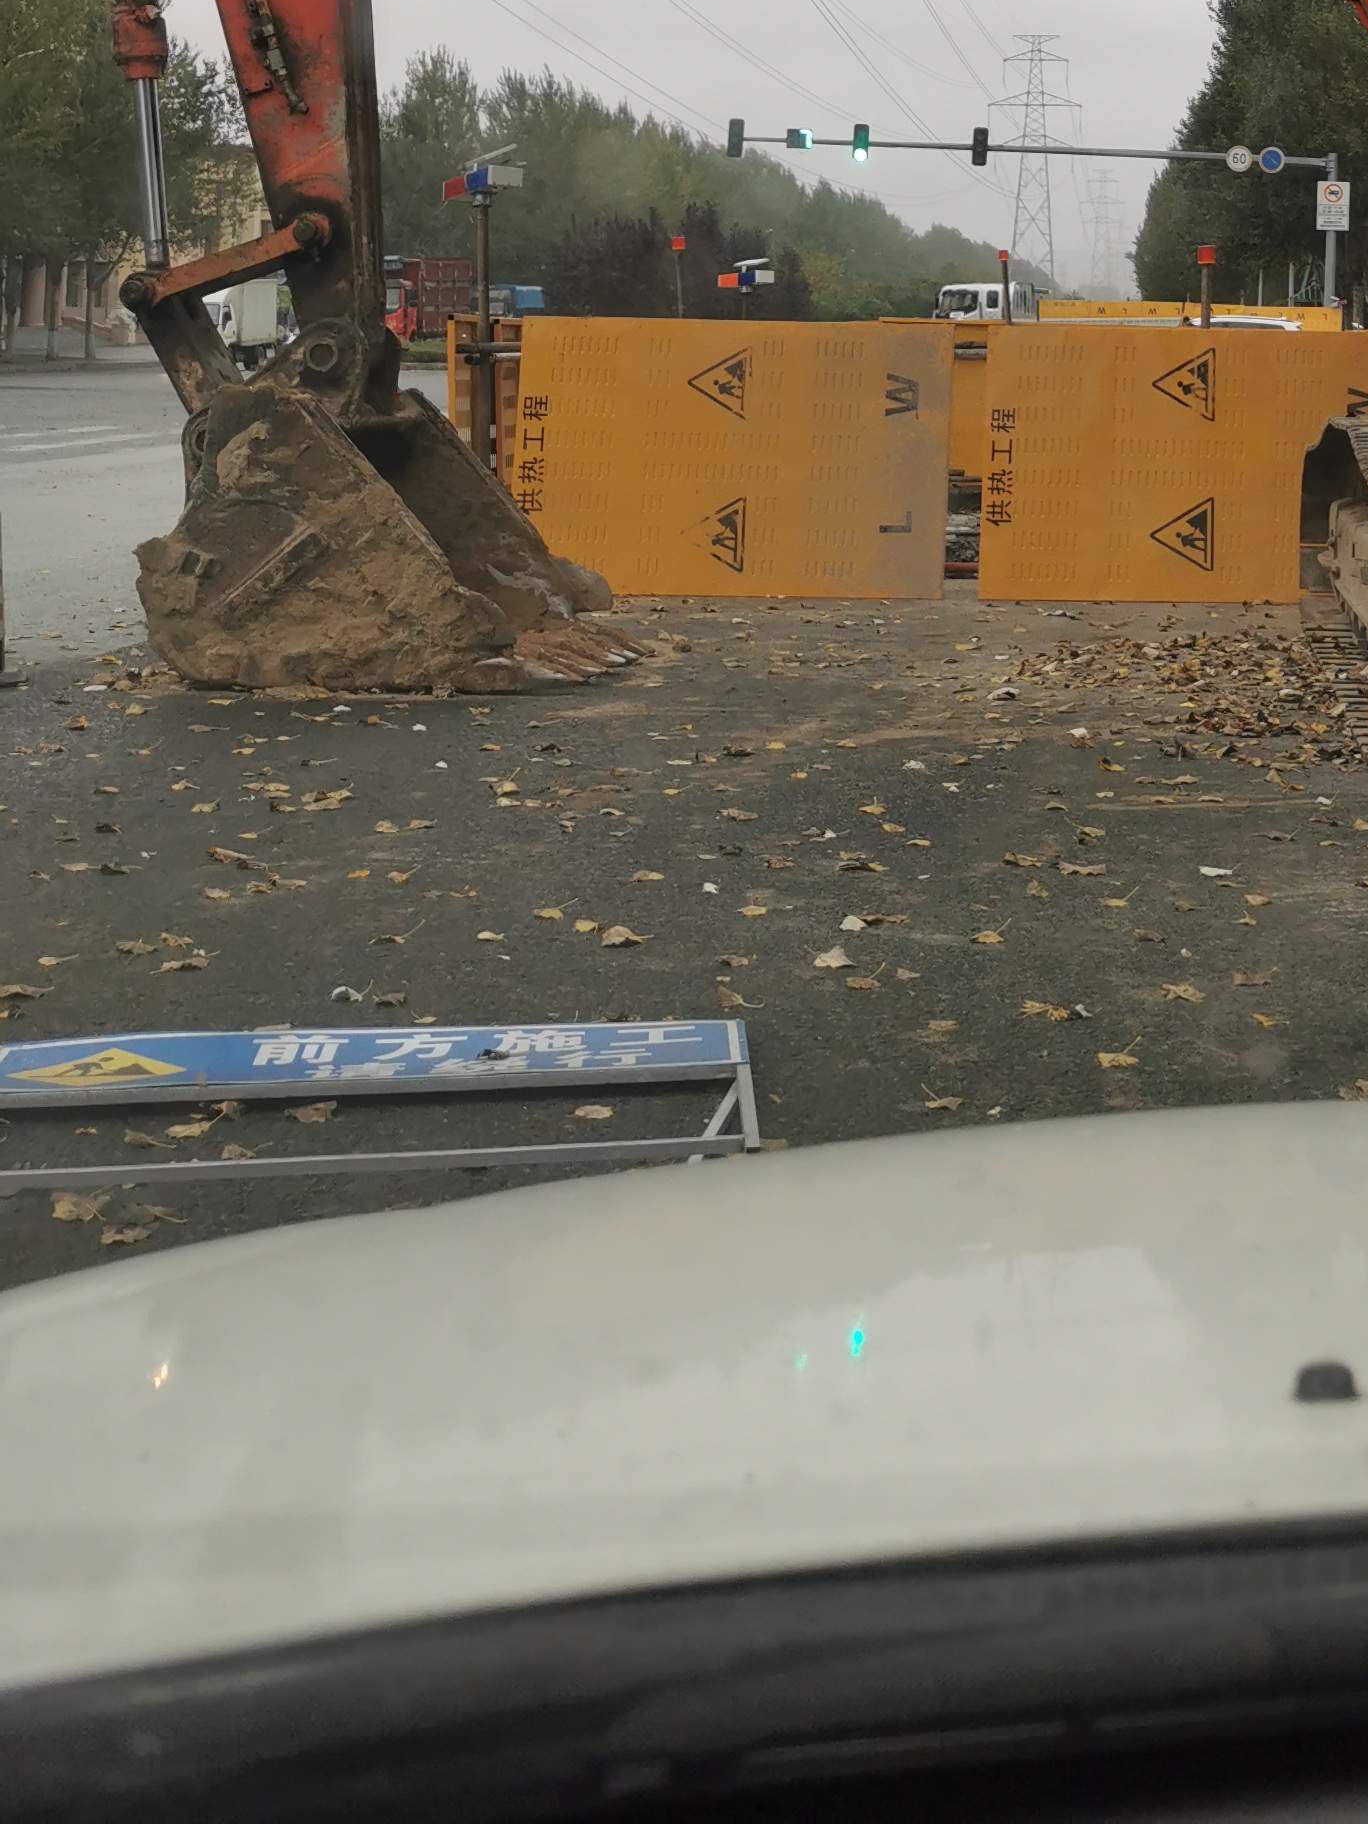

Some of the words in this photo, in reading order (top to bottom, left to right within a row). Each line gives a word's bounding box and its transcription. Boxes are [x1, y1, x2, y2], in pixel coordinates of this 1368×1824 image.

[1232, 153, 1247, 164] 60
[516, 394, 551, 514] 供热工程
[985, 406, 1018, 527] 供热工程
[252, 1024, 704, 1067] 前方施工
